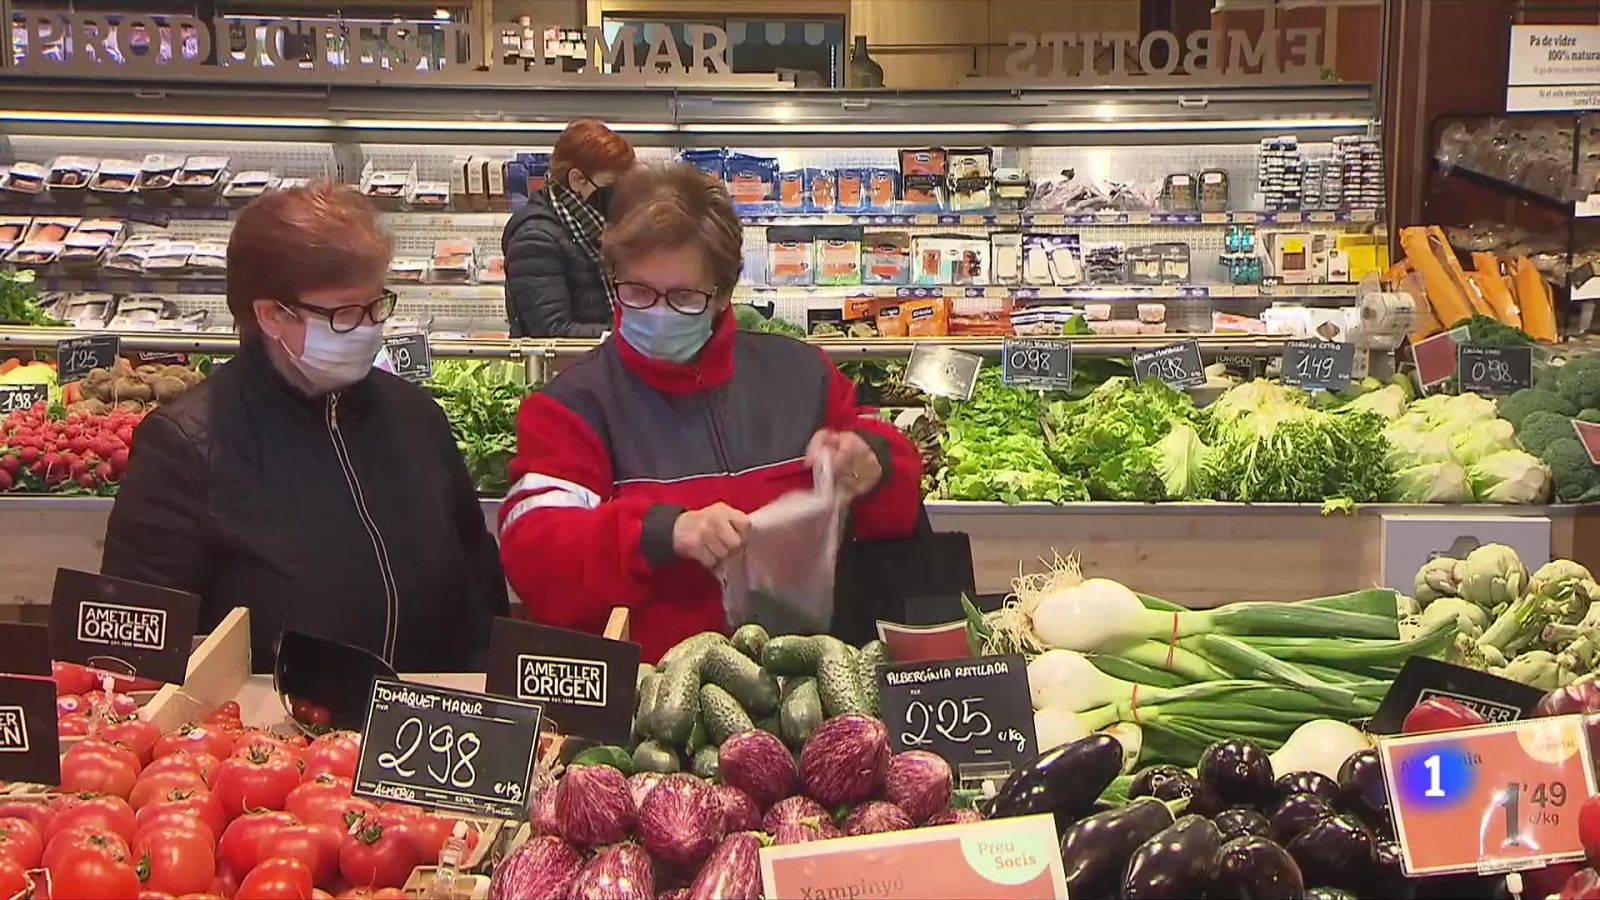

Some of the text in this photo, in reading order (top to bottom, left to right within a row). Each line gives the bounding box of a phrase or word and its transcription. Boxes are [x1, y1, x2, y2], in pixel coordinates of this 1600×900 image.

[1529, 34, 1577, 46] Pa de vidre
[588, 25, 733, 76] MAR
[1548, 49, 1570, 61] 100%
[1011, 350, 1050, 370] 0'98
[85, 607, 160, 627] AMETLLER
[84, 621, 160, 645] ORIGEN
[523, 661, 600, 681] AMETLLER
[523, 675, 600, 700] ORIGEN
[442, 698, 483, 715] MADUR
[901, 696, 992, 745] 2'25
[377, 717, 481, 788] 2'98
[977, 841, 1015, 857] Preu
[994, 854, 1037, 870] Socis
[799, 873, 905, 900] Xampinyó
